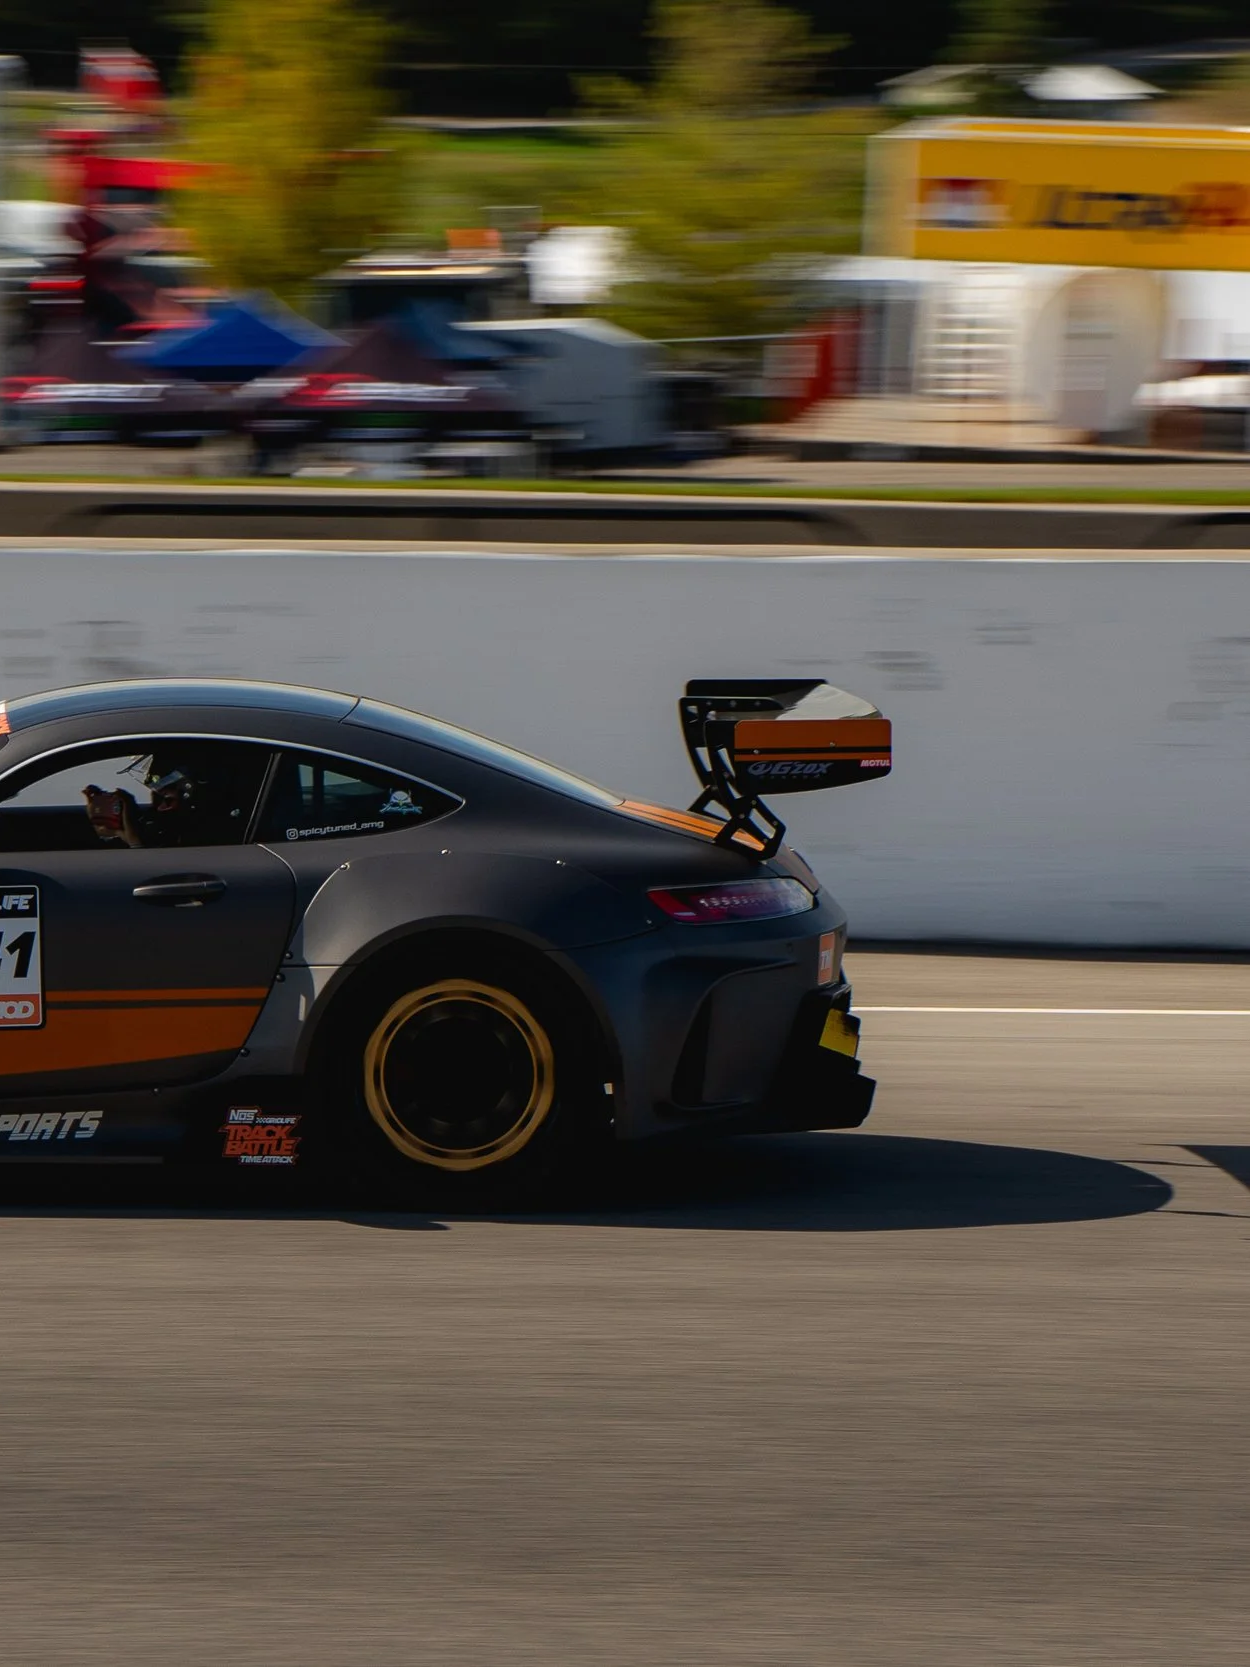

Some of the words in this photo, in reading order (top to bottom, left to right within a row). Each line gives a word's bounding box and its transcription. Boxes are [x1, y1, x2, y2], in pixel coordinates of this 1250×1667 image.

[860, 759, 891, 768] MOTUL
[299, 820, 385, 837] spicytuned_amg
[229, 1109, 258, 1121] NOS
[225, 1125, 291, 1140] TRACK
[225, 1140, 296, 1155] BATTLE
